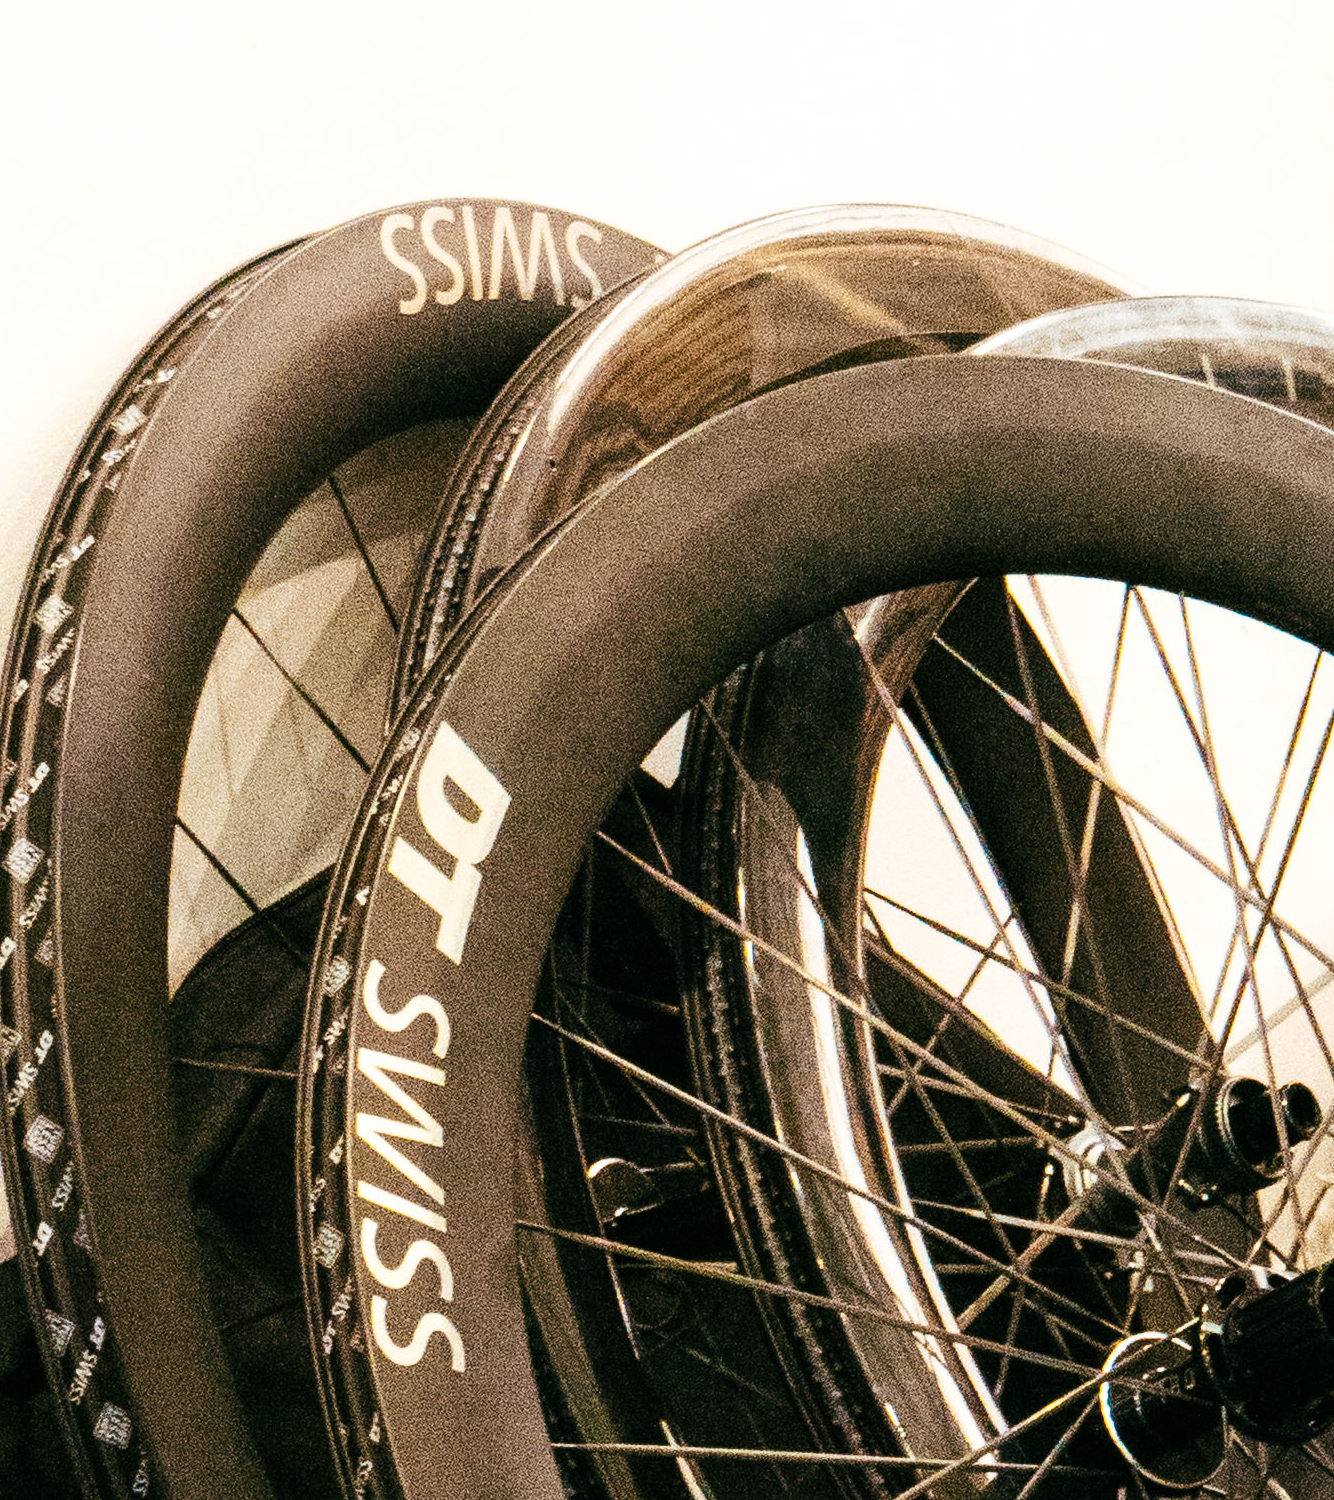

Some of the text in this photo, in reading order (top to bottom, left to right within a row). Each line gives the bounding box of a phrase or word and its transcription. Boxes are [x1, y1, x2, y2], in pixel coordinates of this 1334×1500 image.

[380, 205, 603, 316] SWISS
[355, 720, 513, 1374] DT SWISS
